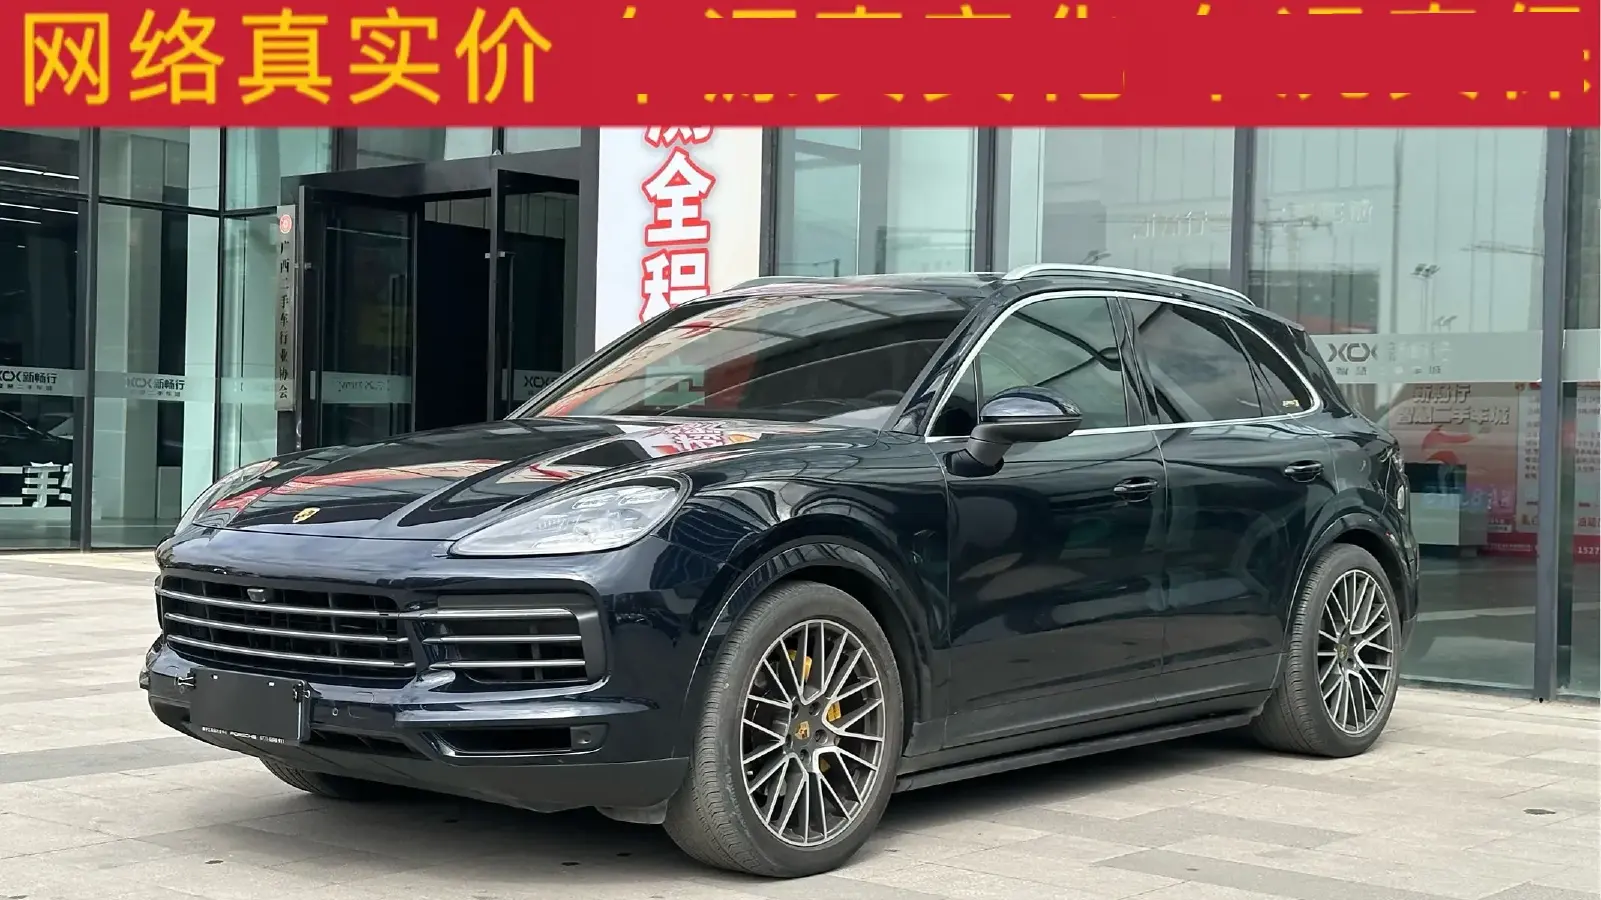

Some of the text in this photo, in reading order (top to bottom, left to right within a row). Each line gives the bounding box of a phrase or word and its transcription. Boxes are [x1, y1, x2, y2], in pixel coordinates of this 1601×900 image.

[278, 240, 291, 400] 广西二手车行业协会
